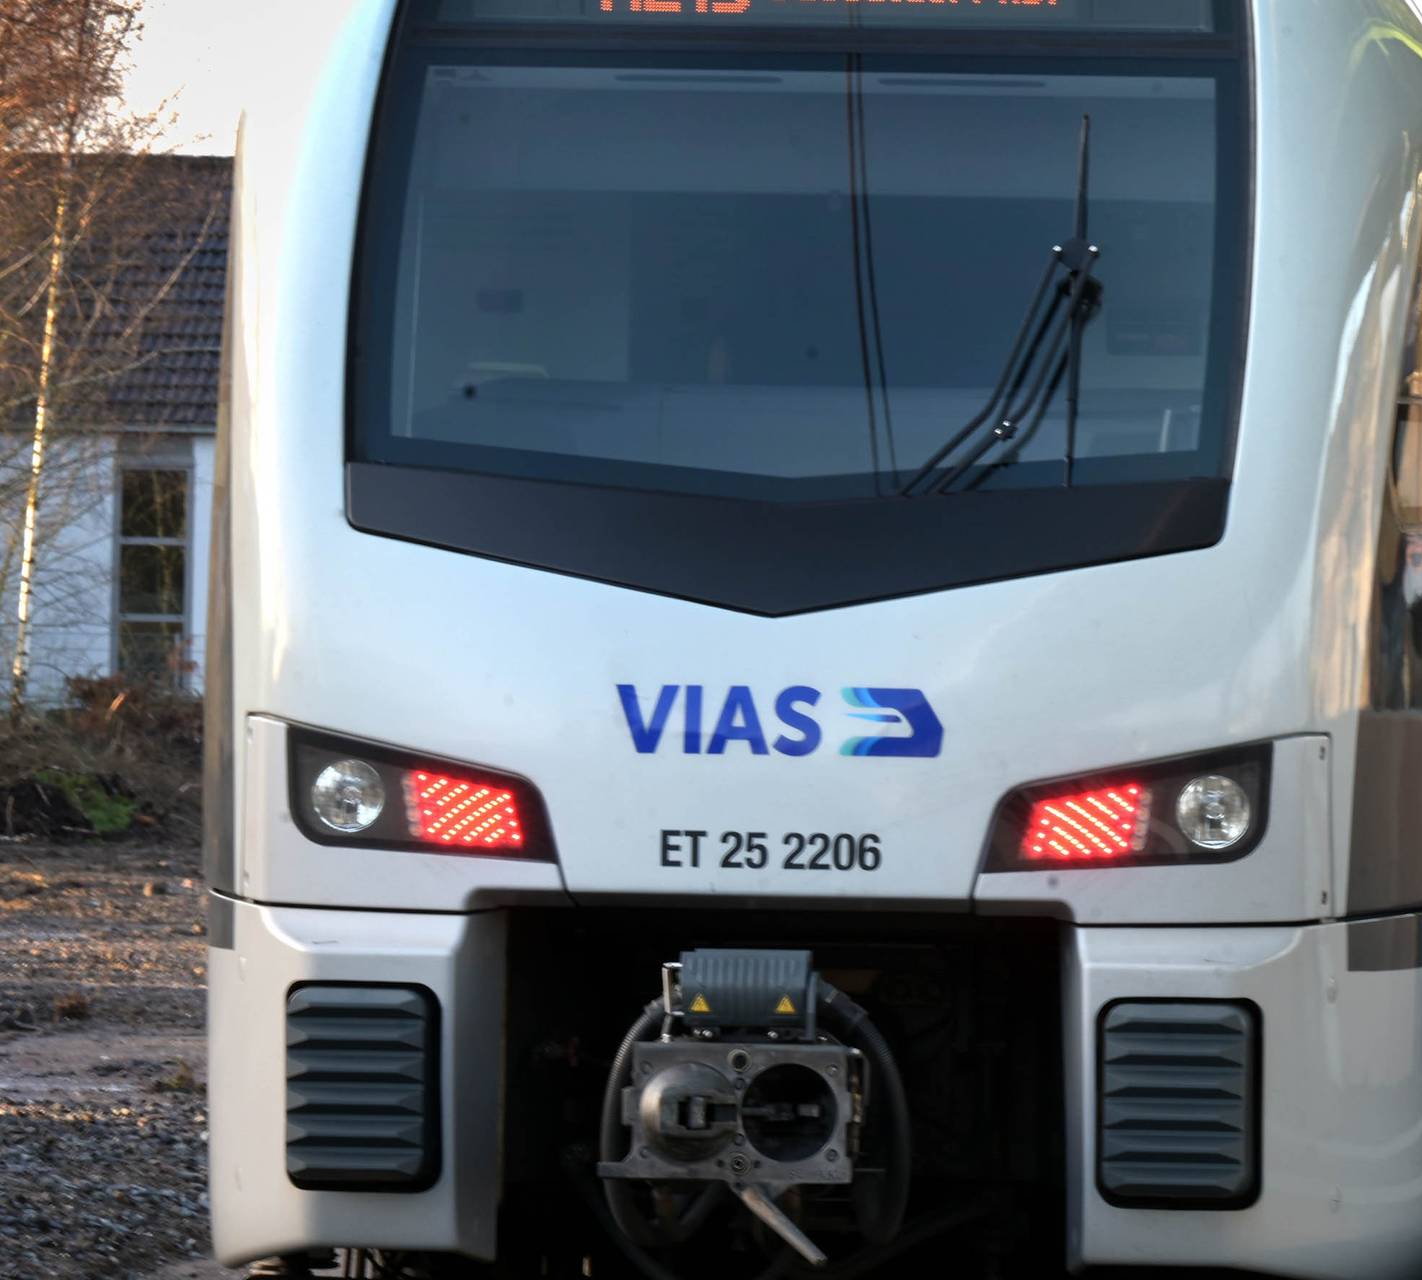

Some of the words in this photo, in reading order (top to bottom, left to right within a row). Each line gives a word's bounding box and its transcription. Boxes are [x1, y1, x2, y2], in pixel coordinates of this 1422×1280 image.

[616, 684, 822, 757] VIAS
[660, 829, 707, 868] ET
[720, 831, 769, 869] 25
[783, 832, 882, 871] 2206
